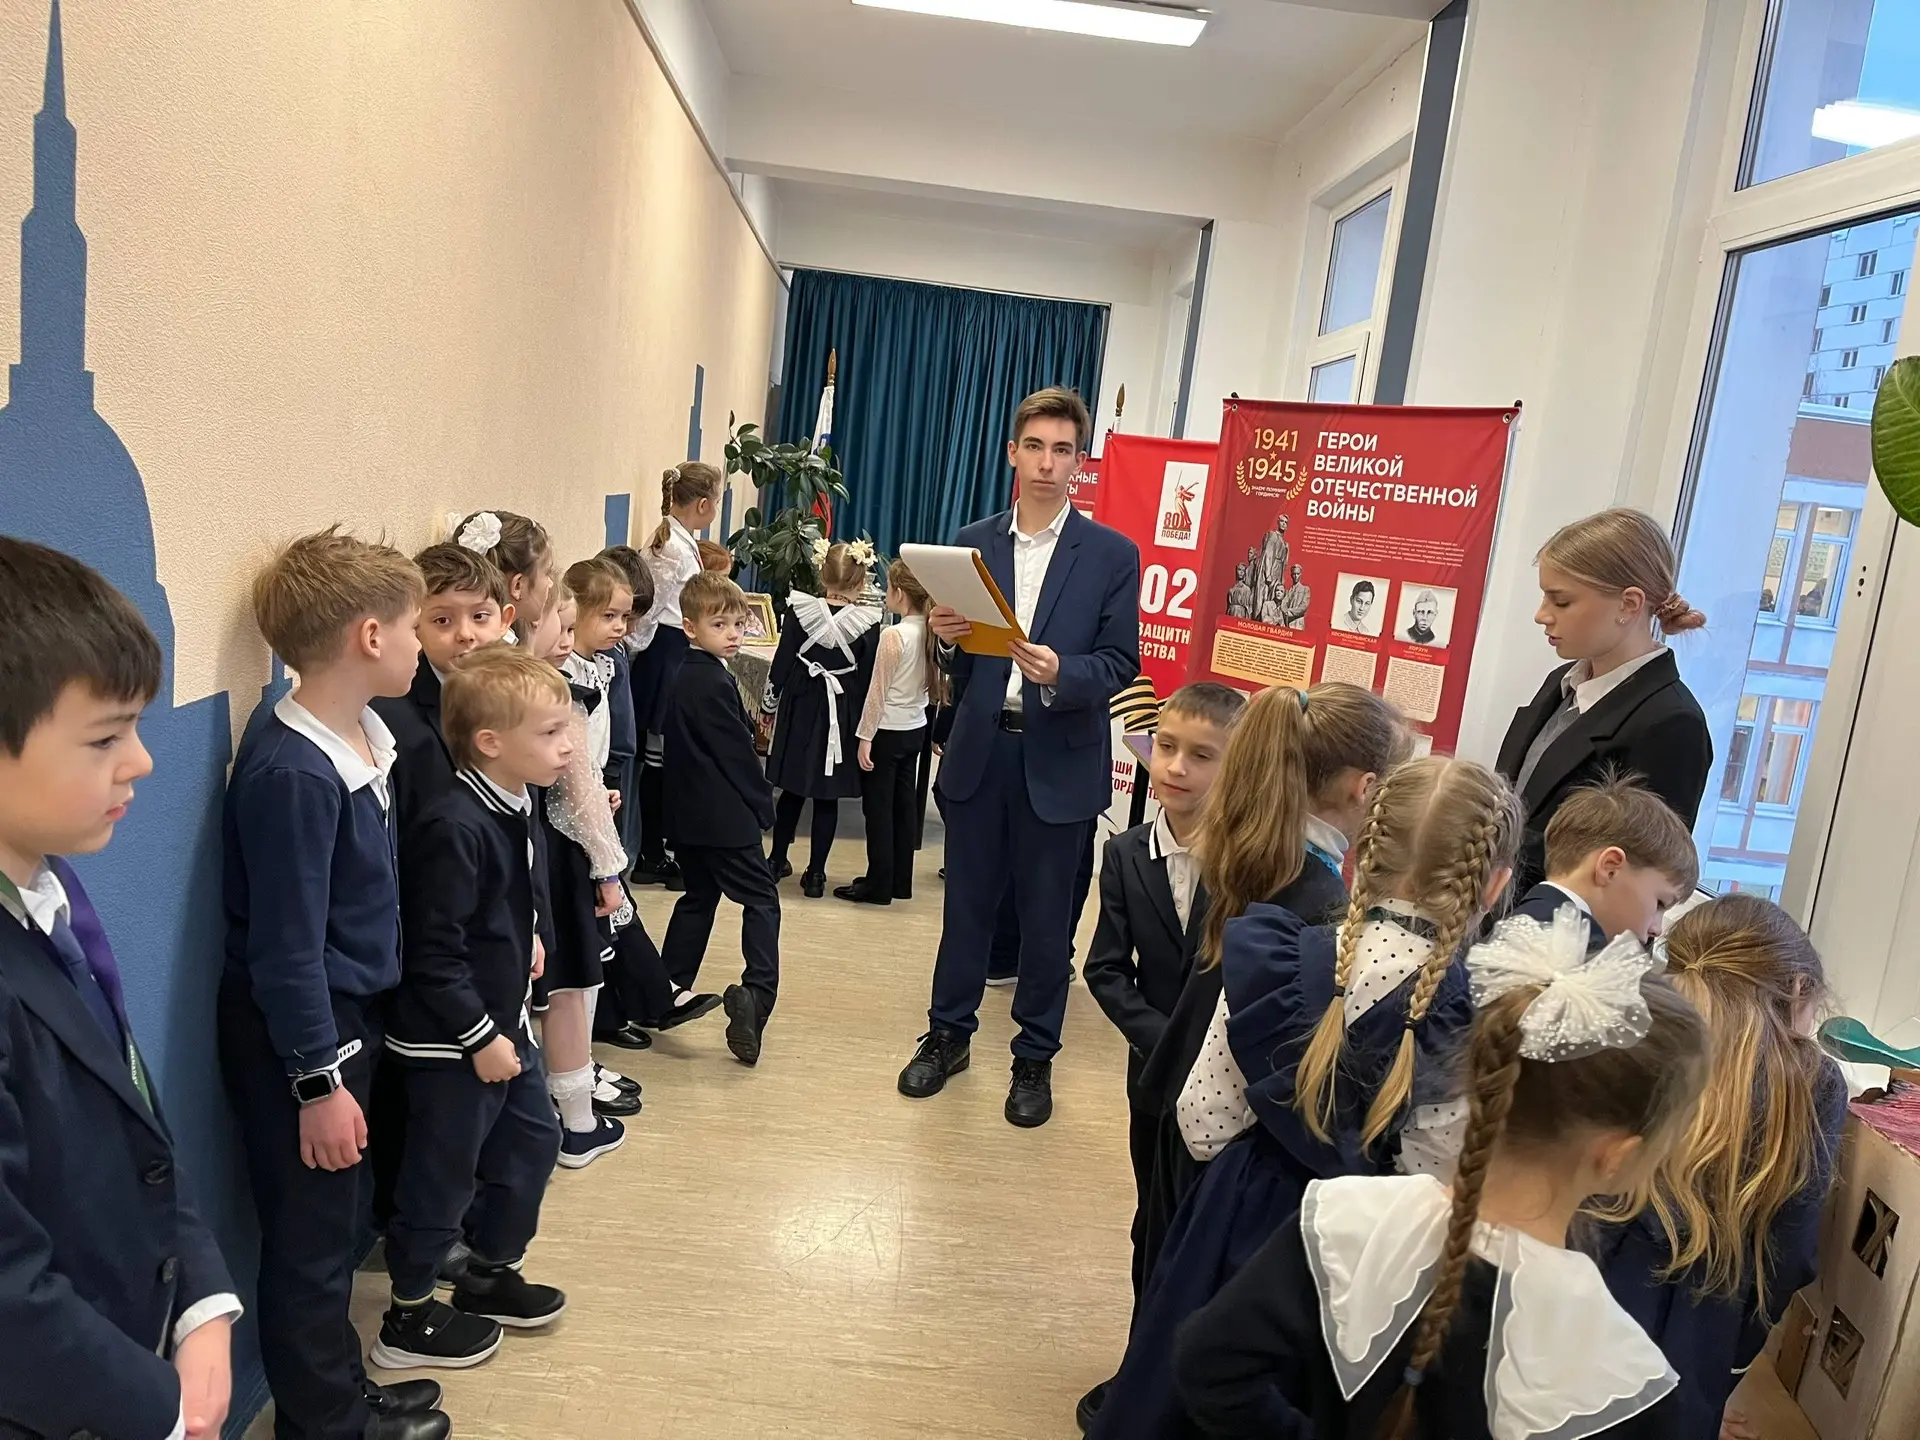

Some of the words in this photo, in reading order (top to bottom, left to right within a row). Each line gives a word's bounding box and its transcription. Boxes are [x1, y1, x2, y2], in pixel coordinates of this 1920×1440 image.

[1254, 428, 1299, 452] 1941
[1316, 431, 1379, 452] ГЕРОИ
[1247, 457, 1297, 483] 1945
[1313, 454, 1404, 478] ВЕЛИКОЙ
[1309, 477, 1478, 508] ОТЕЧЕСТВЕННОЙ
[1163, 511, 1181, 529] 80
[1306, 499, 1376, 524] ВОЙНЫ
[1160, 529, 1192, 541] ПОБЕДА!
[1139, 563, 1199, 620] 02
[1138, 621, 1192, 645] ЗАЩИТН
[1237, 620, 1267, 633] МОЛОДАЯ
[1267, 626, 1294, 638] ГВАРДИЯ
[1138, 640, 1177, 661] ЕСТВА
